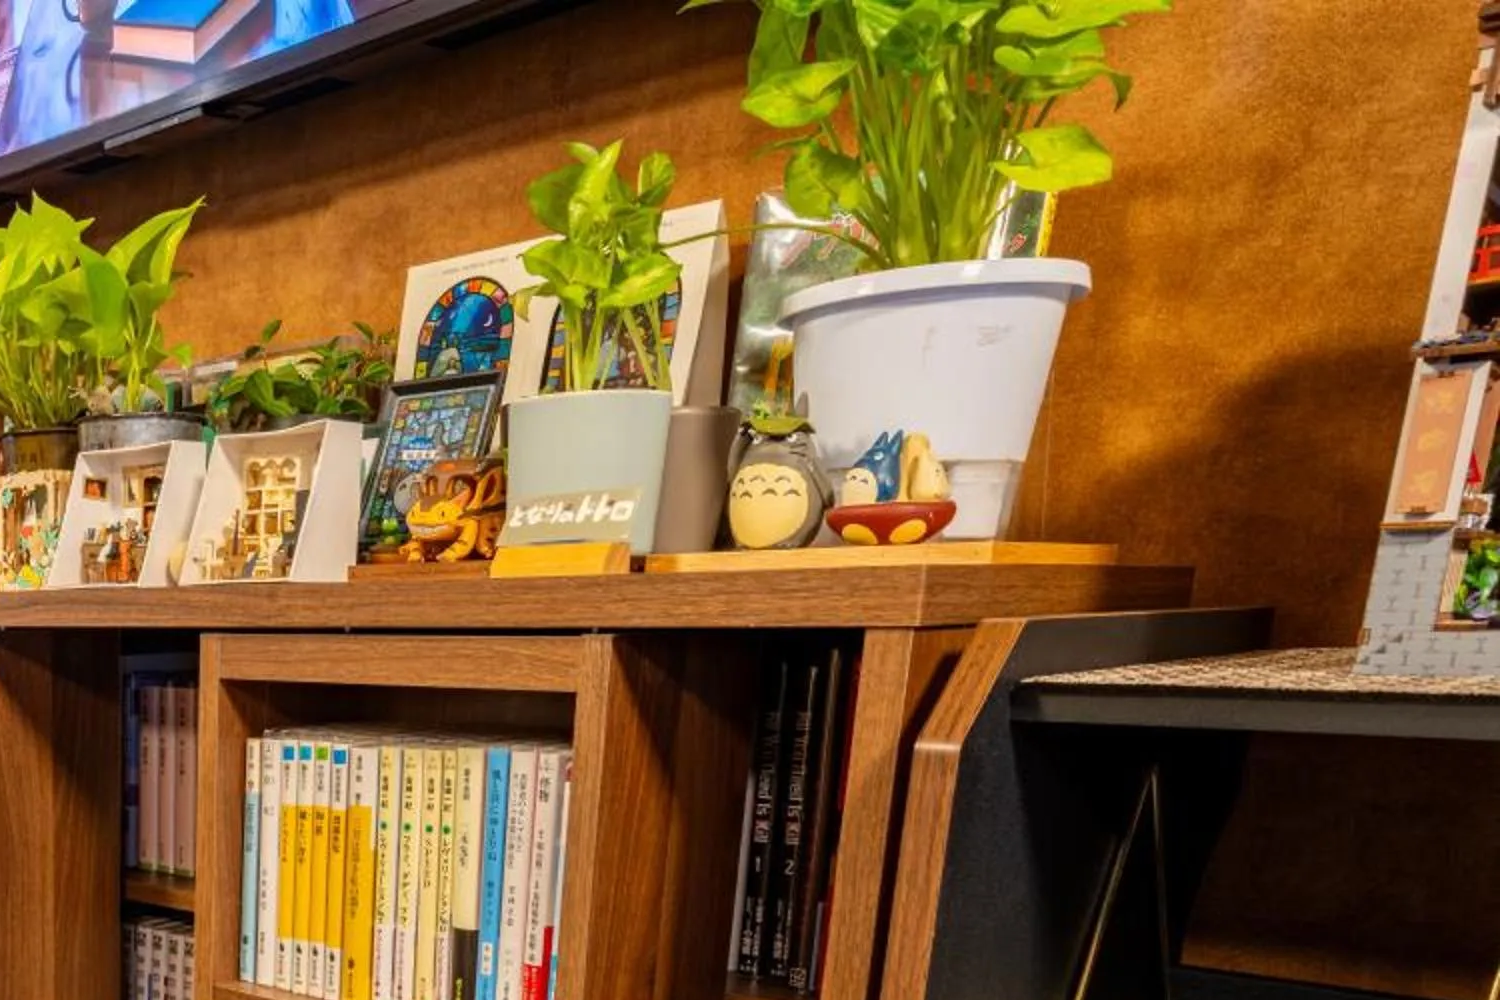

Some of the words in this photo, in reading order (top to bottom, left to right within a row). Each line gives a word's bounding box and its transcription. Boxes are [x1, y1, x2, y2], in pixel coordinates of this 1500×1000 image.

[509, 492, 635, 528] となりのトトロ
[784, 858, 796, 876] 2
